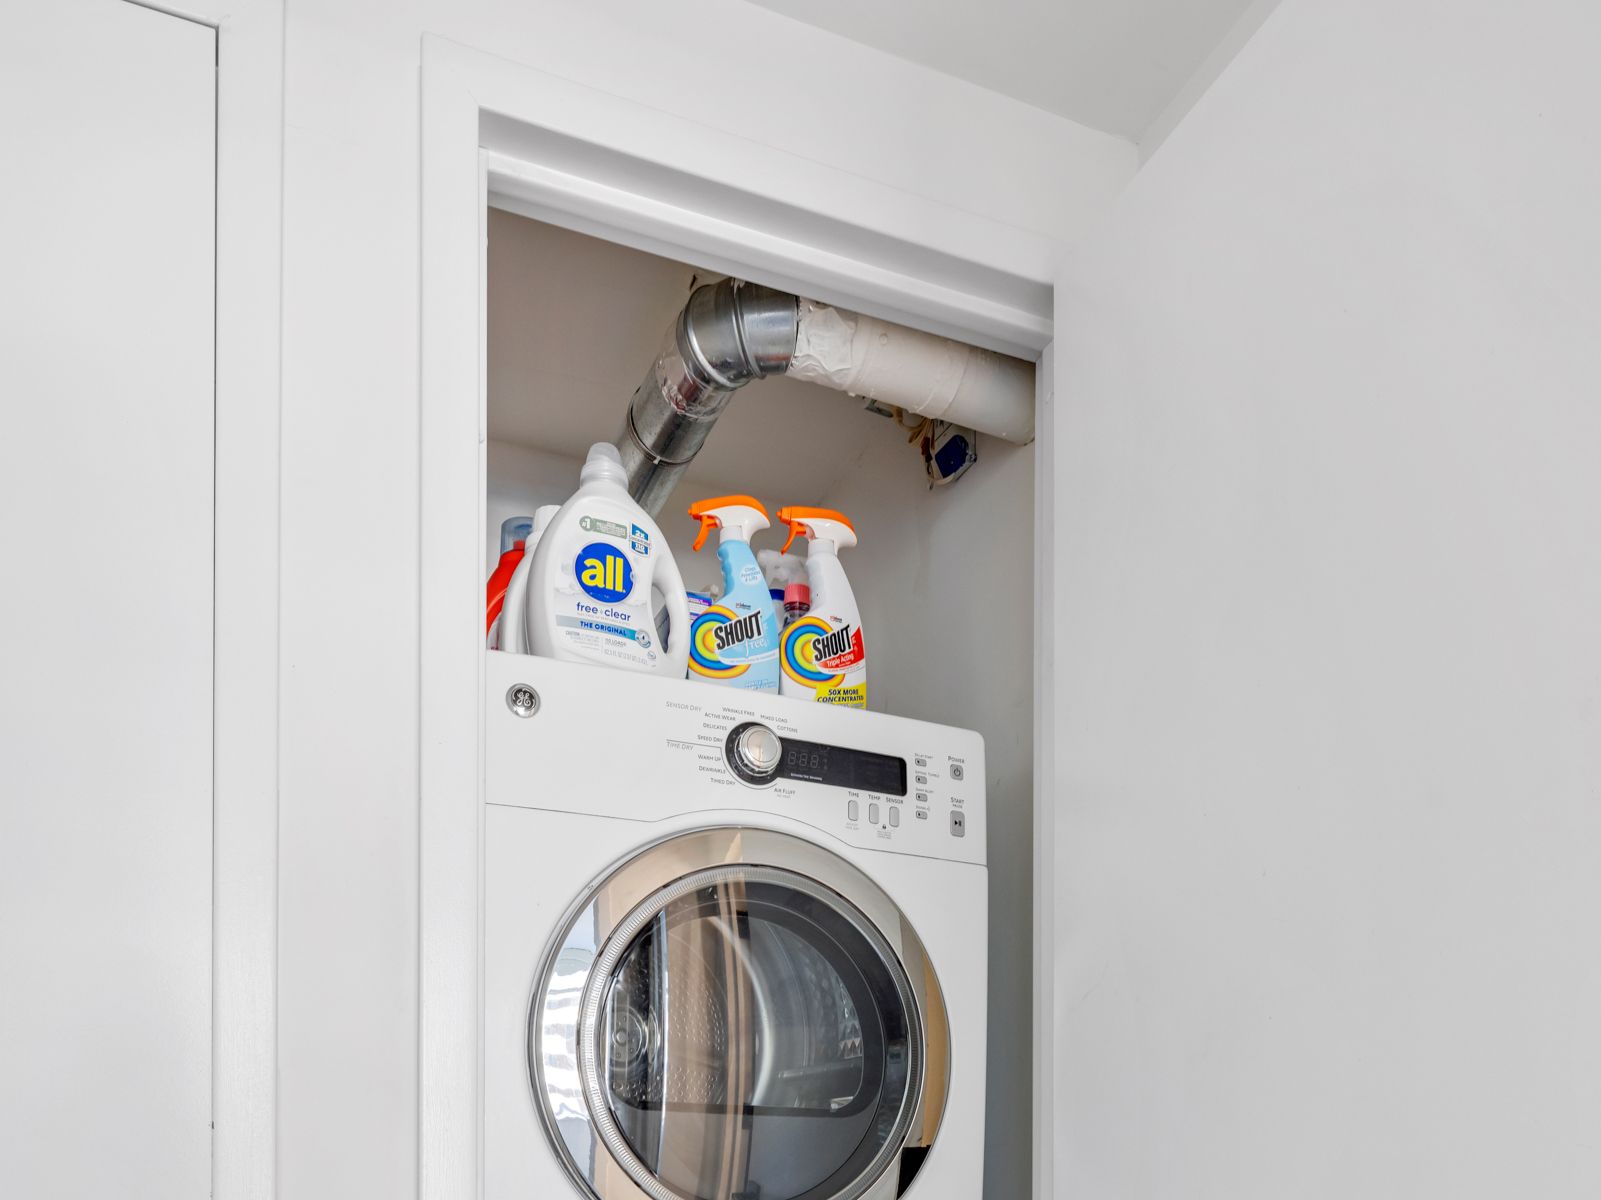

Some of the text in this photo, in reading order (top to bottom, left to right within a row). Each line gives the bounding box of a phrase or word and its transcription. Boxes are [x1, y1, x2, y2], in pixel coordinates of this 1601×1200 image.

[581, 555, 625, 592] all
[576, 602, 598, 614] free
[604, 607, 631, 621] clear
[580, 620, 627, 637] THE ORIGINAL
[714, 611, 761, 650] SHOUT
[812, 624, 851, 662] SHOUT
[817, 695, 865, 703] CONCENTRATED
[828, 688, 842, 696] 50X
[666, 701, 702, 713] SENSOR DRY
